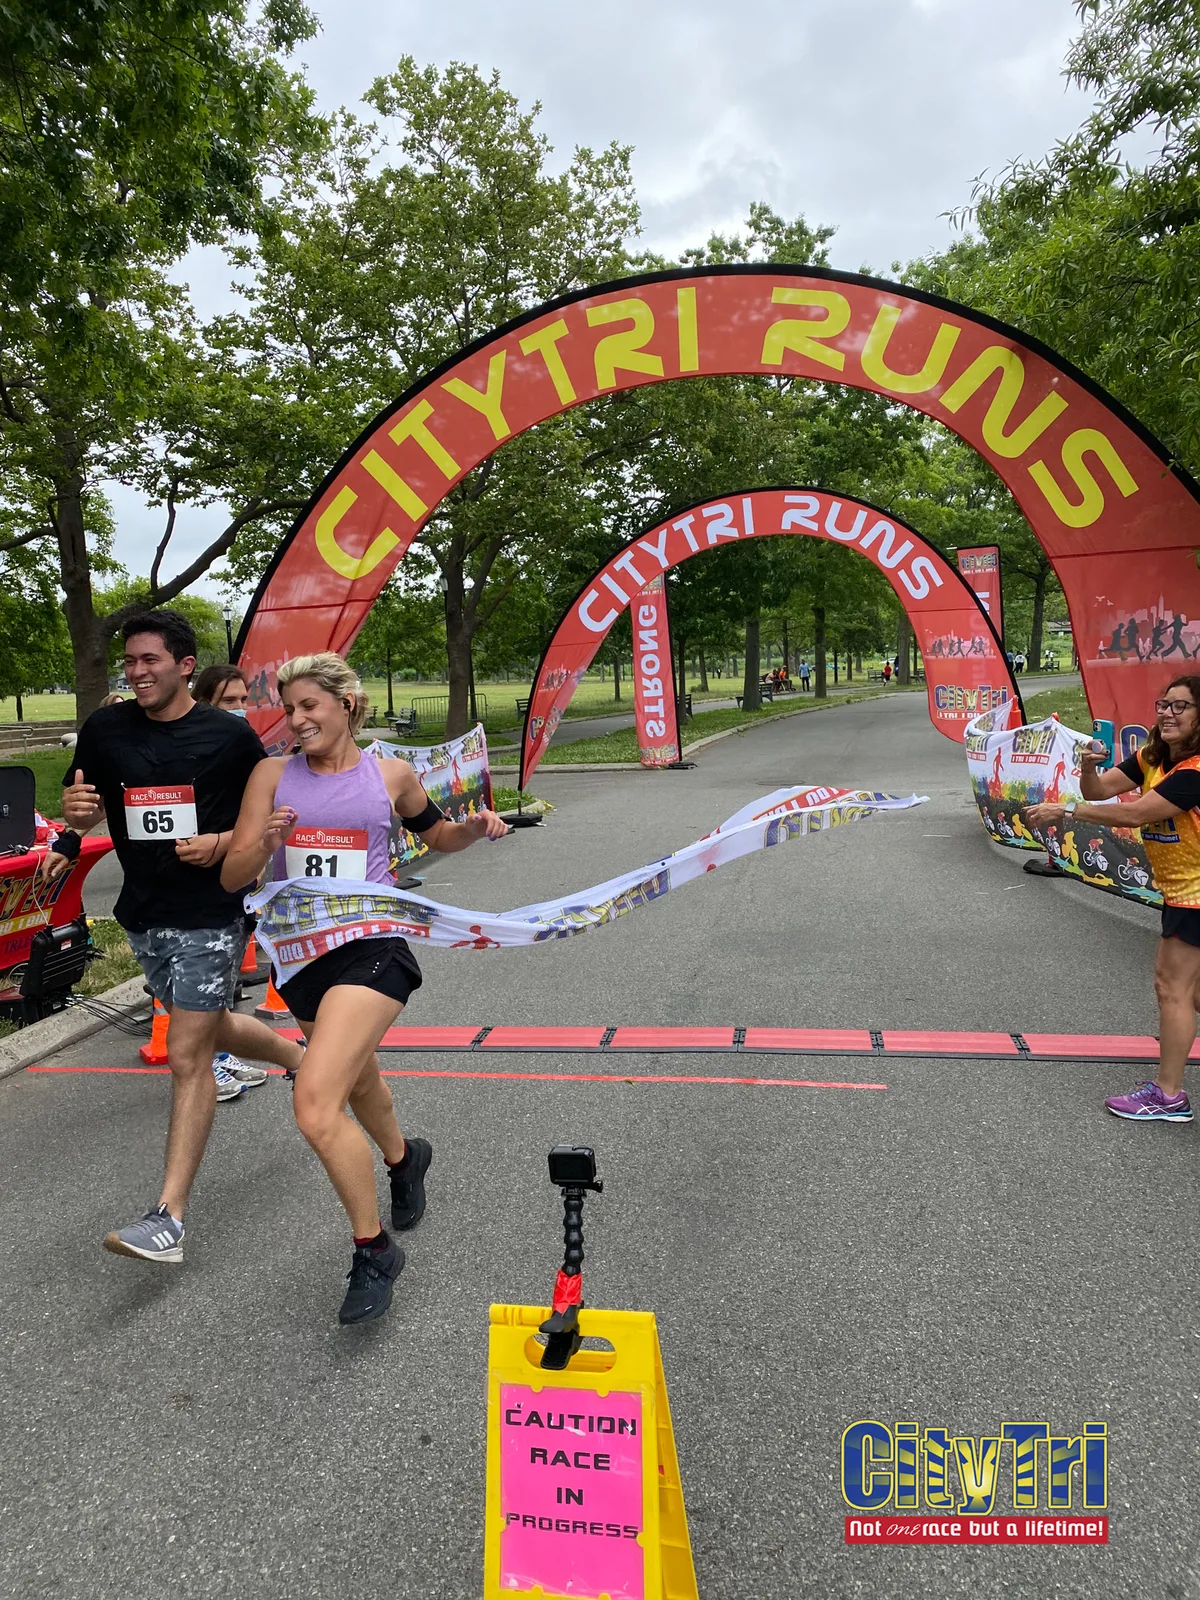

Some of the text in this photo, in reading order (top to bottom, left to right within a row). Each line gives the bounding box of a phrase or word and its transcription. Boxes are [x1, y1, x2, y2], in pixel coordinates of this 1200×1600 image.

[315, 287, 1140, 580] CITYTRI RUNS
[578, 495, 944, 633] CITYTRI RUNS
[934, 685, 1008, 711] CityTri
[156, 791, 182, 800] RESULT
[143, 810, 174, 834] 65
[296, 834, 355, 844] RACE RESULT
[305, 854, 338, 878] 81
[505, 1408, 637, 1436] CAUTION
[530, 1447, 611, 1471] RACE
[557, 1487, 583, 1505] IN
[506, 1512, 638, 1540] PROGRESS
